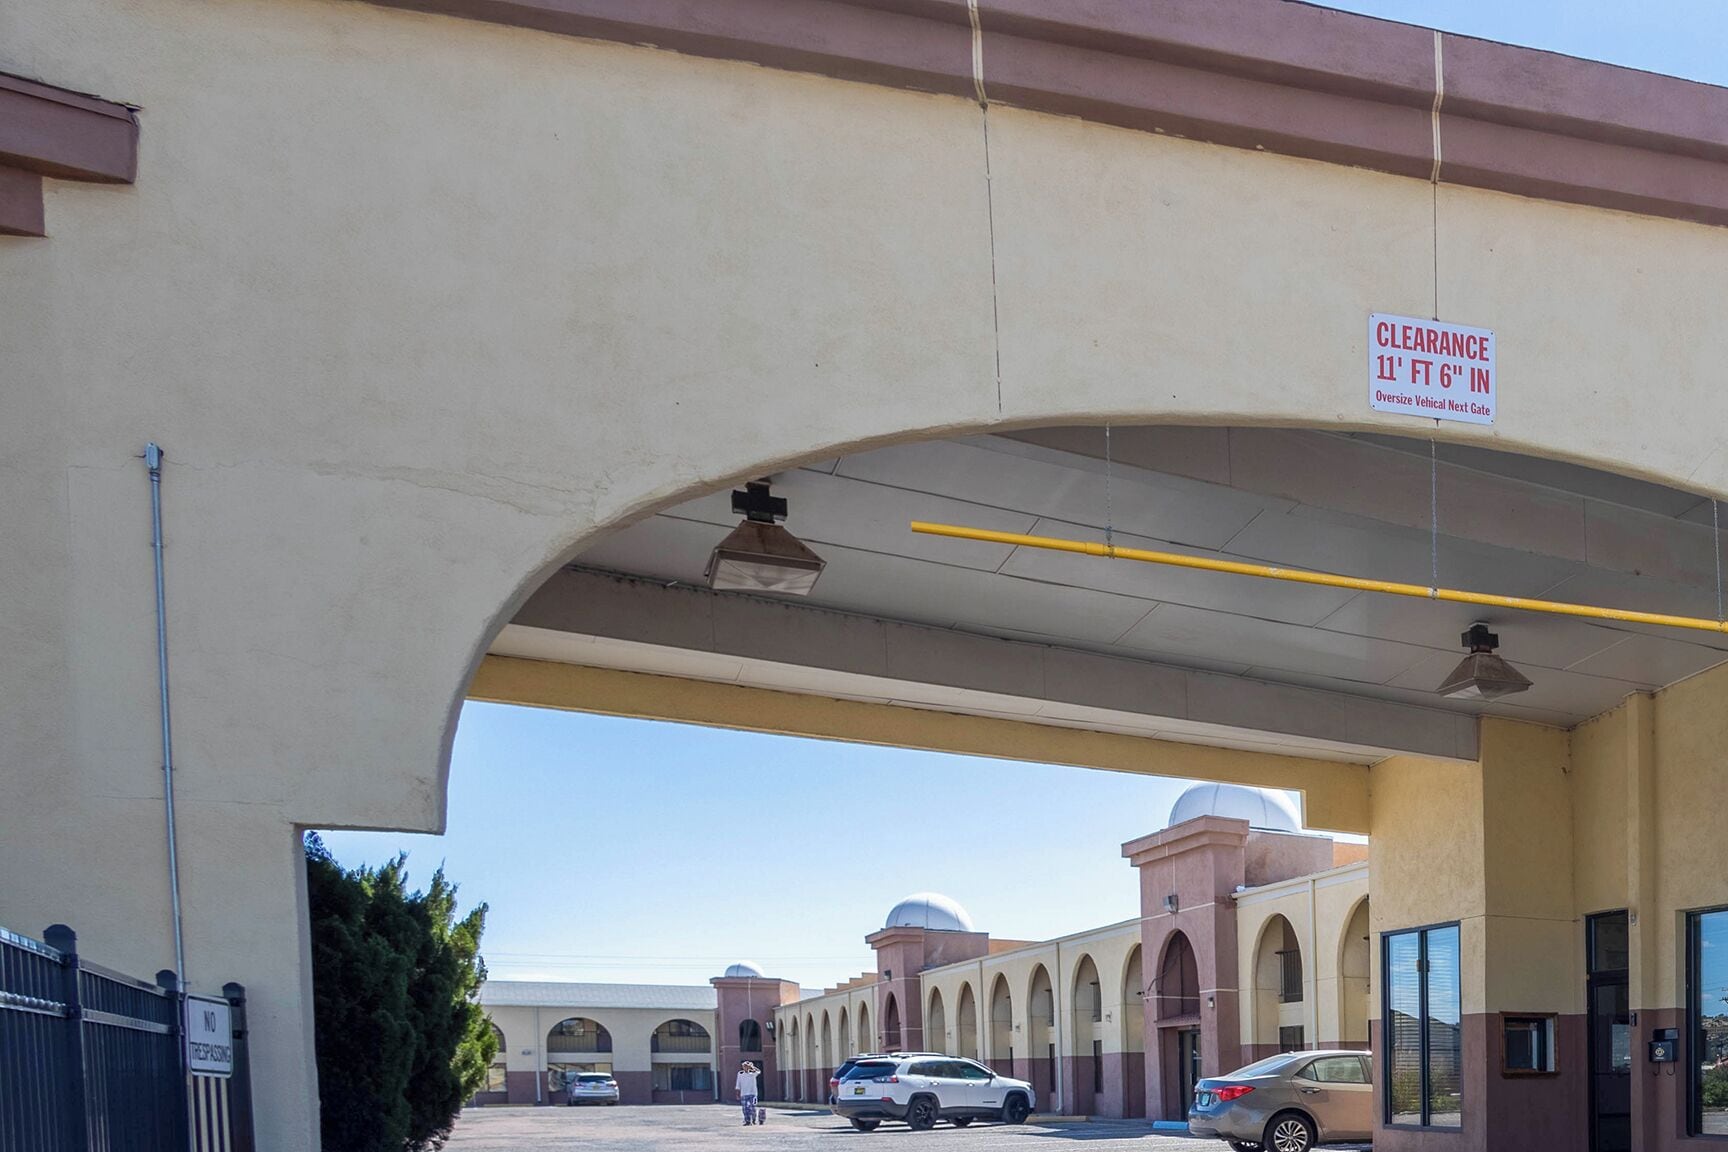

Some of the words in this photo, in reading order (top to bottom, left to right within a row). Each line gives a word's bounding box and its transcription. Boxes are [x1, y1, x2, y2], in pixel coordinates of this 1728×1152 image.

[1376, 321, 1490, 362] CLEARANCE
[1376, 354, 1402, 381] 11'
[1411, 358, 1433, 386] FT
[1439, 363, 1463, 389] 6"
[1470, 367, 1490, 394] IN
[1375, 390, 1413, 405] Oversize
[1415, 395, 1446, 410] Vehical
[1448, 399, 1468, 413] Next
[1470, 402, 1491, 416] Gate
[203, 1010, 217, 1033] NO
[190, 1041, 231, 1063] TRESPASSING
